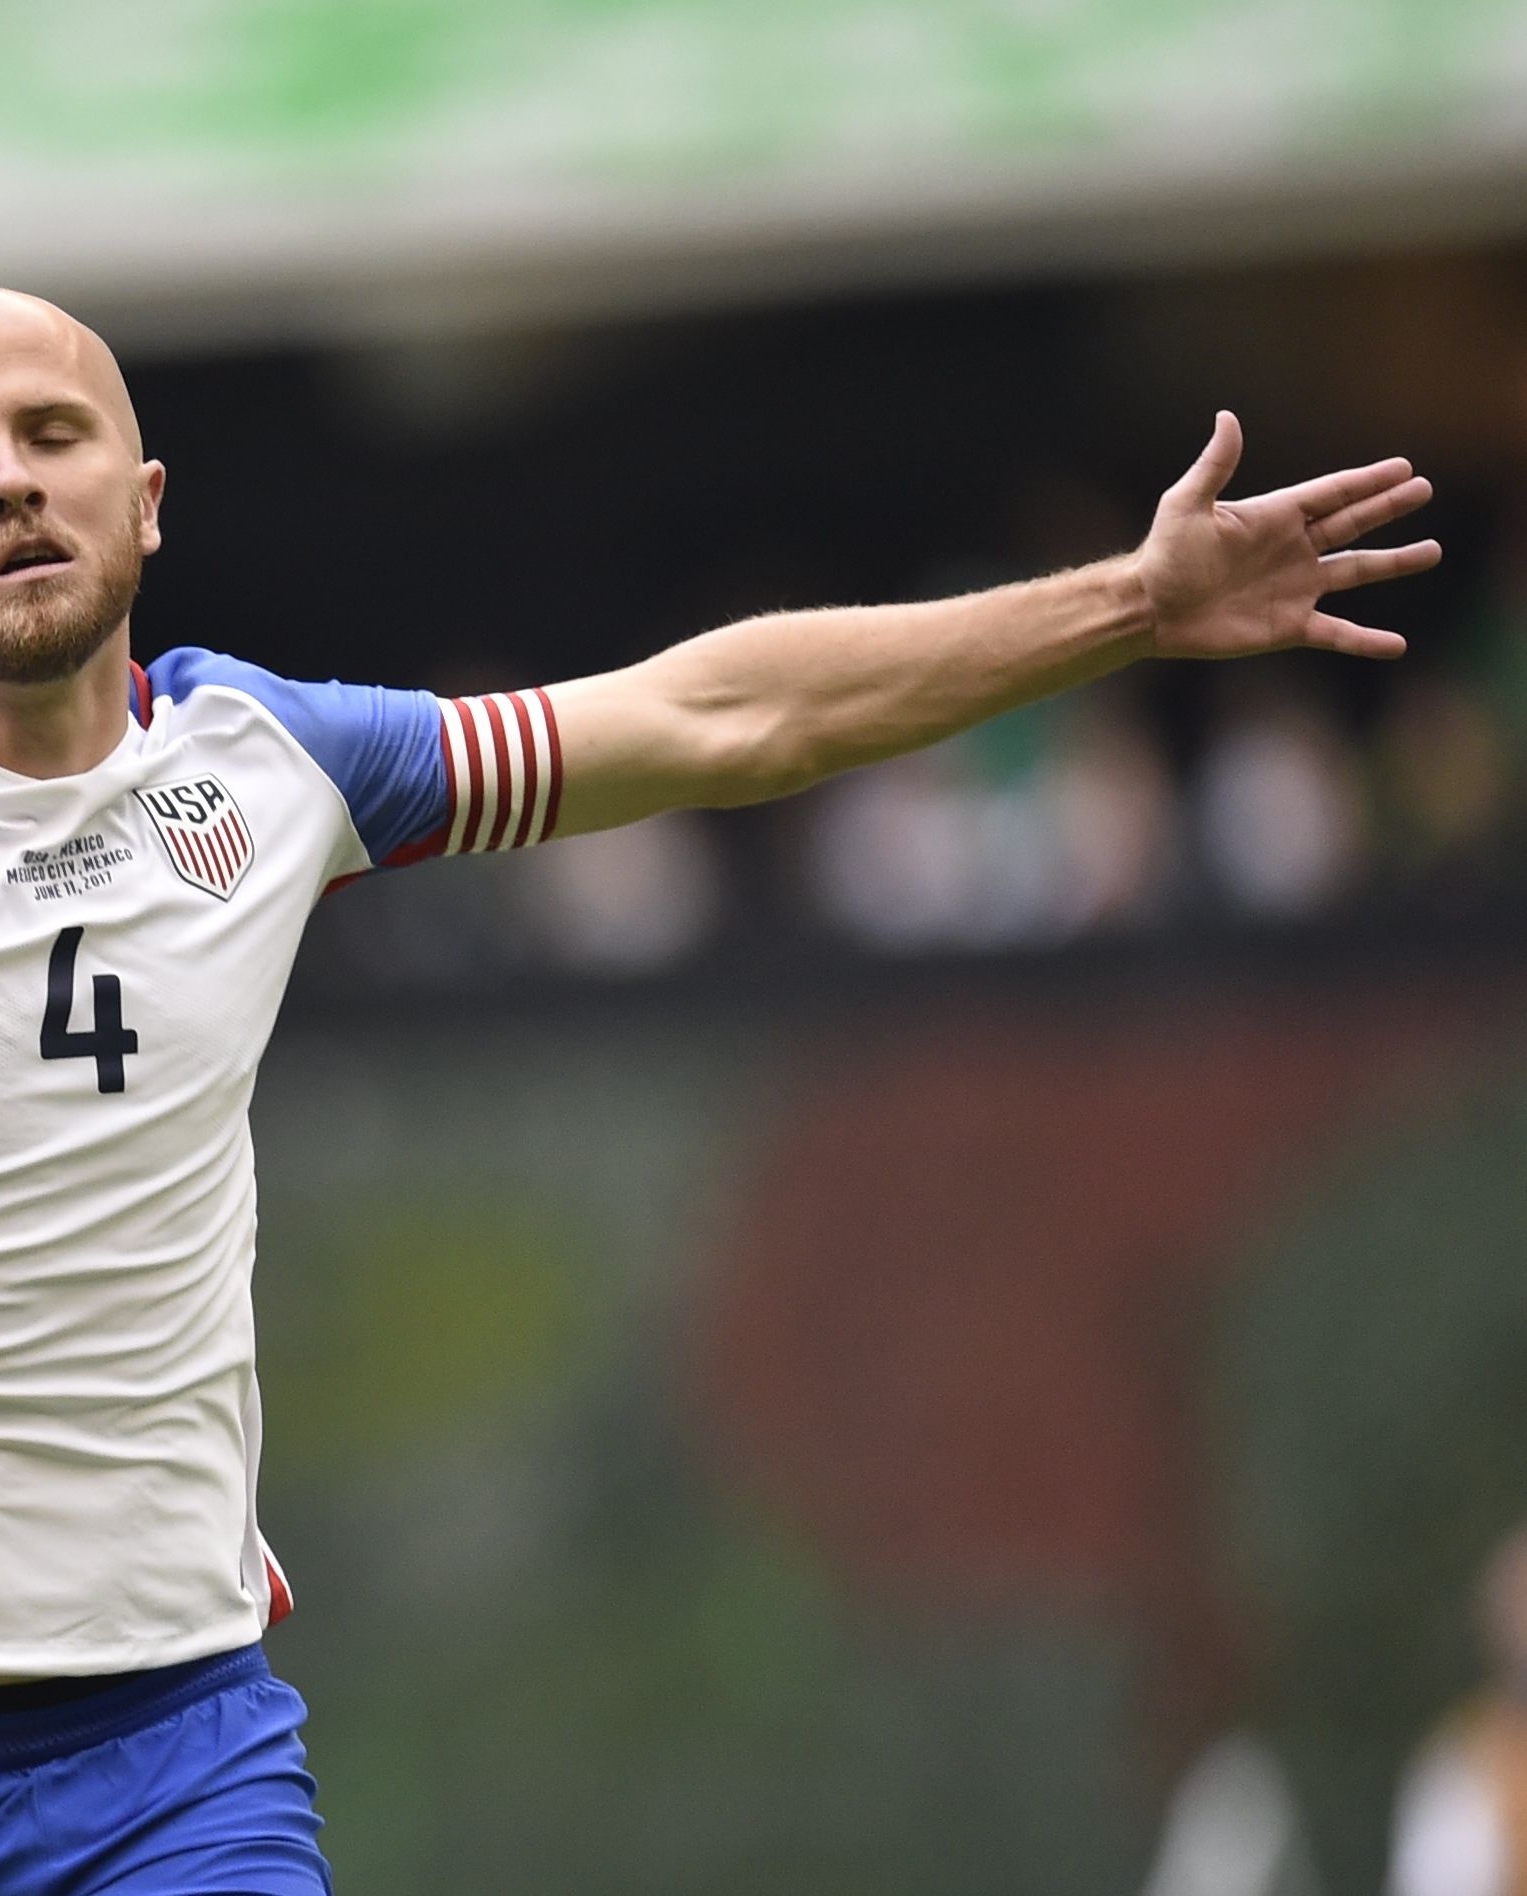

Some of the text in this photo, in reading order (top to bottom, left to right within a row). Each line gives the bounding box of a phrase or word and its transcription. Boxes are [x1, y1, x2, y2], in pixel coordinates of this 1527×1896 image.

[147, 779, 225, 824] USA
[60, 834, 105, 859] MEXICO
[82, 849, 133, 872] MEXICO
[34, 885, 62, 900] JUNE
[83, 871, 113, 890] 2017
[41, 926, 138, 1094] 4
